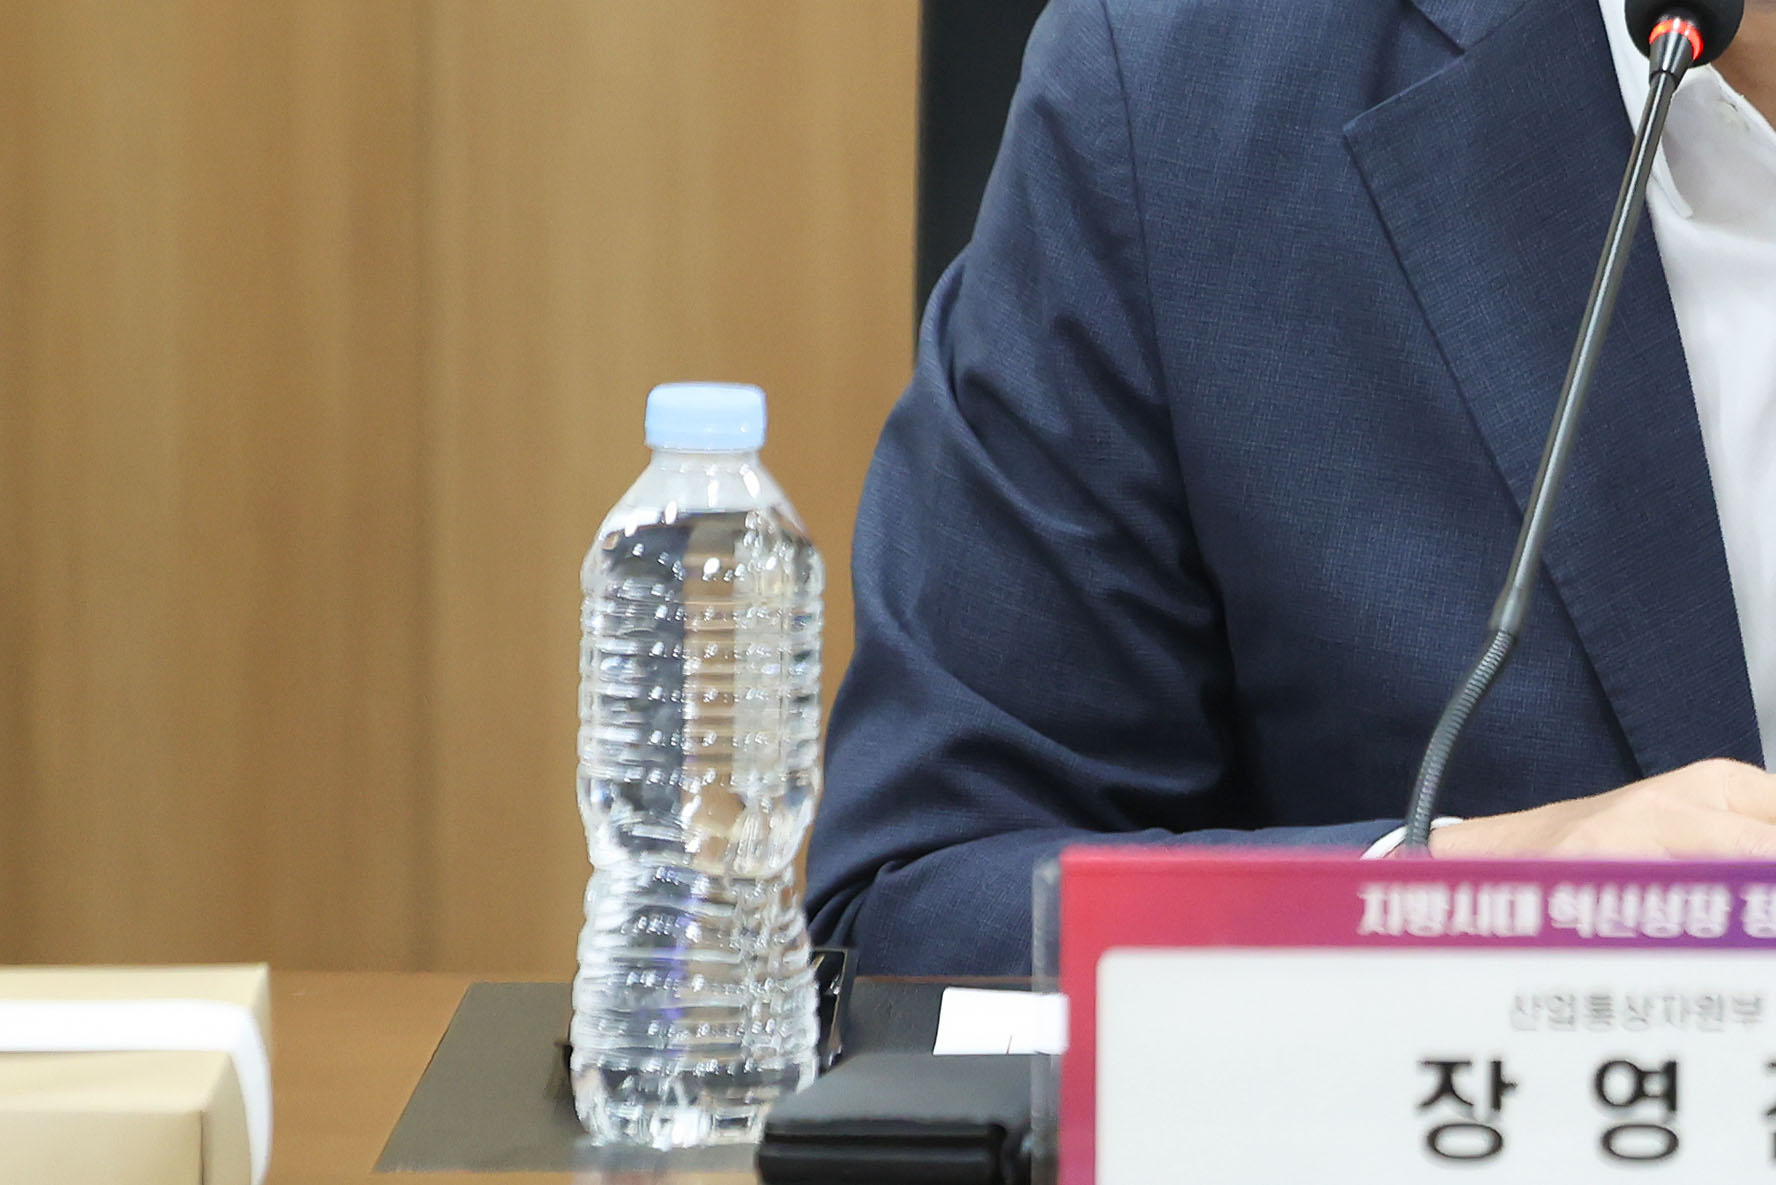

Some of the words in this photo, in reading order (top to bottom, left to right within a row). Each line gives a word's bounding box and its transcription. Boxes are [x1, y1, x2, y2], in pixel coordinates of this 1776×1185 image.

[1357, 882, 1542, 937] 지방시대
[1547, 882, 1731, 938] 혁신성장
[1510, 990, 1766, 1033] 산업통상자원부
